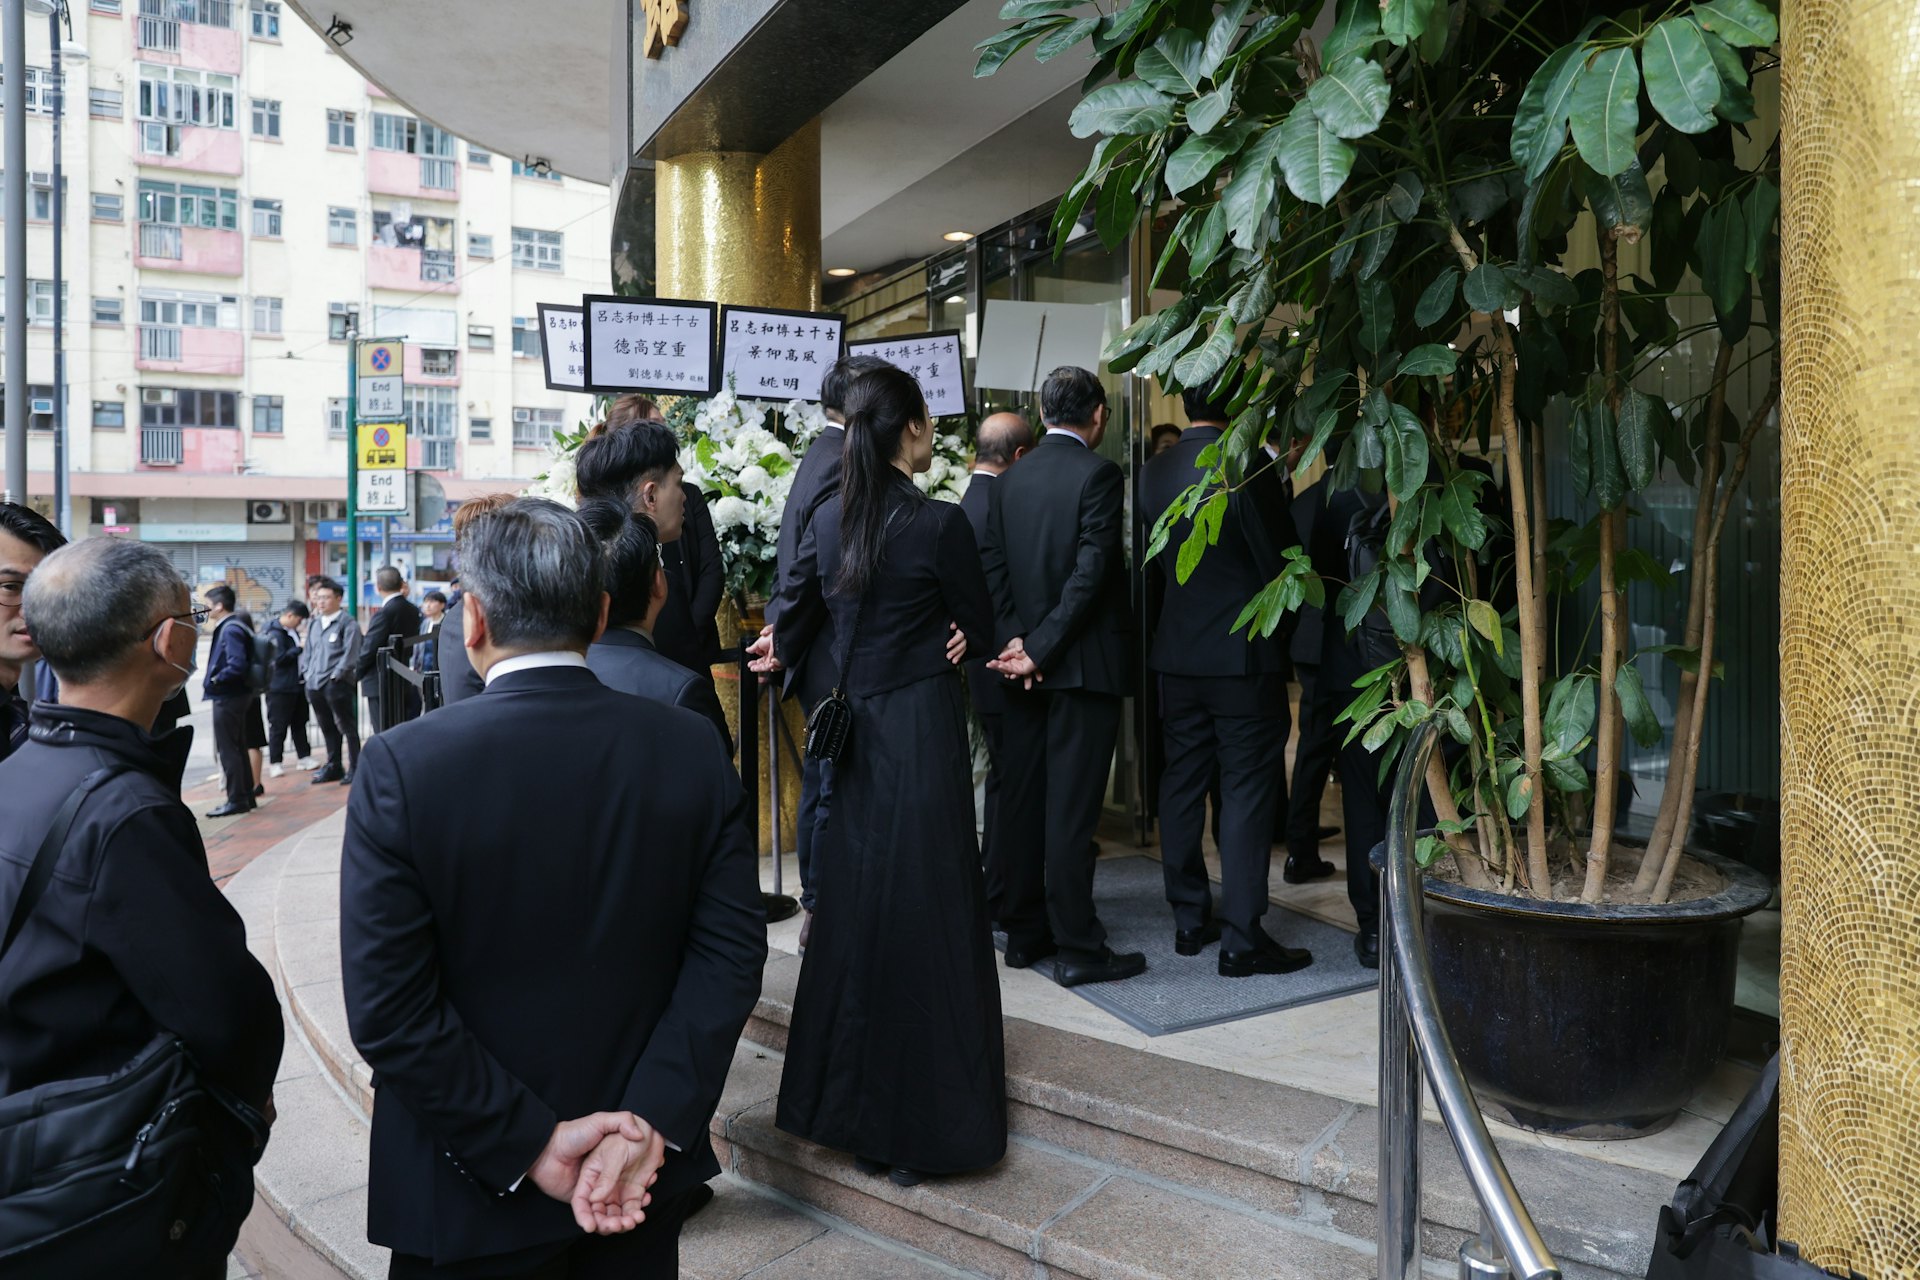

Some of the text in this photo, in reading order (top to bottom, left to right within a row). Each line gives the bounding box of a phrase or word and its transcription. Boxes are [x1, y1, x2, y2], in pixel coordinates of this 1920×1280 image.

[549, 316, 583, 330] 呂志和
[597, 310, 700, 328] 呂志和博士千古
[729, 319, 836, 341] 呂志和博士千古
[613, 337, 687, 357] 德高望重
[628, 367, 685, 382] 劉德華夫婦
[372, 382, 390, 392] End
[758, 376, 800, 391] 姚明
[369, 398, 394, 411] 終止
[371, 475, 392, 486] End
[367, 491, 396, 505] 終止
